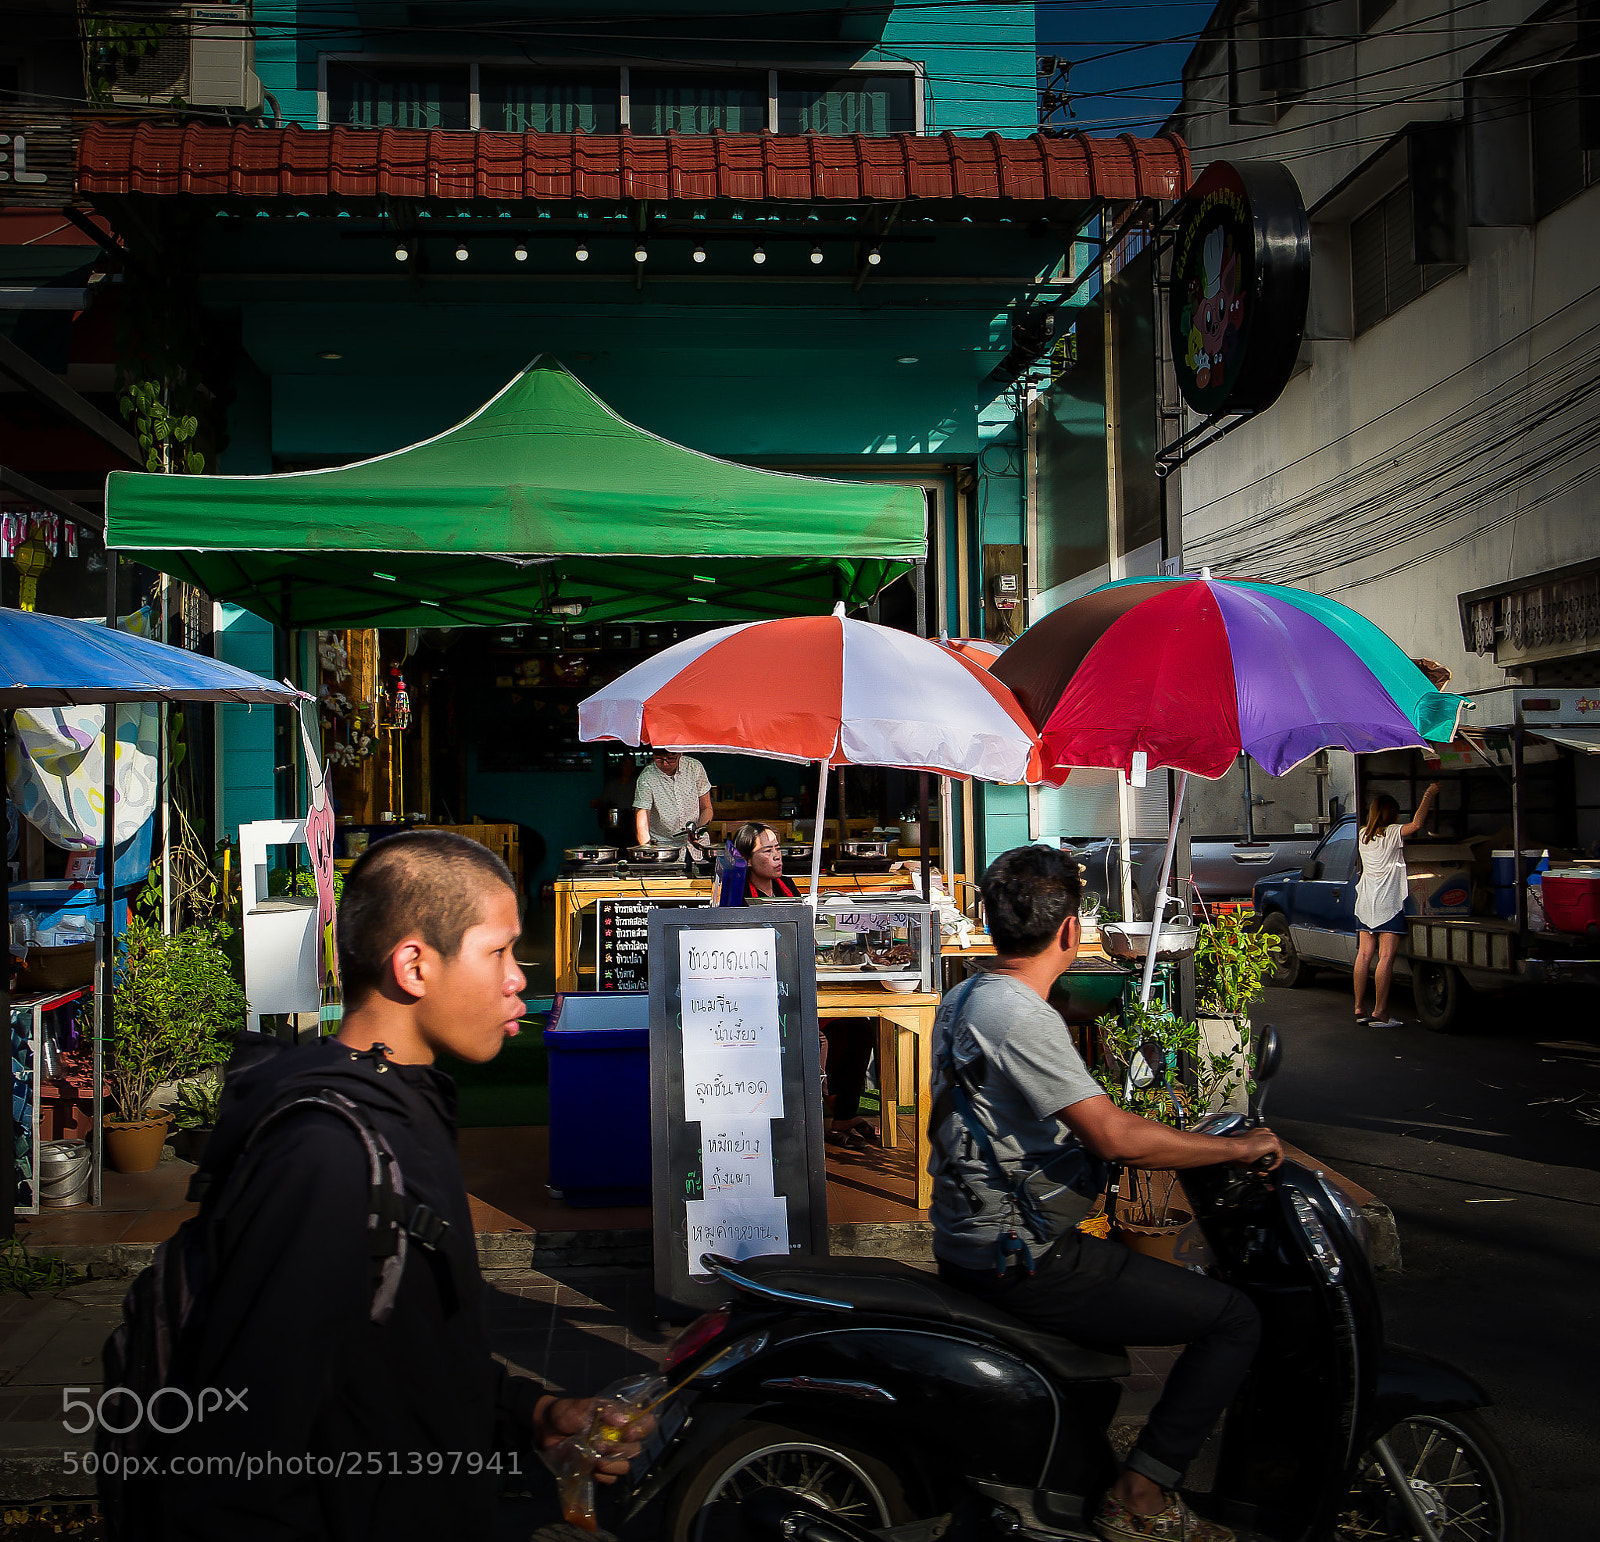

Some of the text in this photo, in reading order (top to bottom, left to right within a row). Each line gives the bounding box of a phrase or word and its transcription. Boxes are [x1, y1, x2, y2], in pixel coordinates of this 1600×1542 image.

[196, 10, 239, 19] Panasonic
[688, 946, 769, 971] ข้าวราดแกง
[708, 1131, 760, 1153] หมึกย่าง
[712, 1166, 752, 1192] กุ้งเผา
